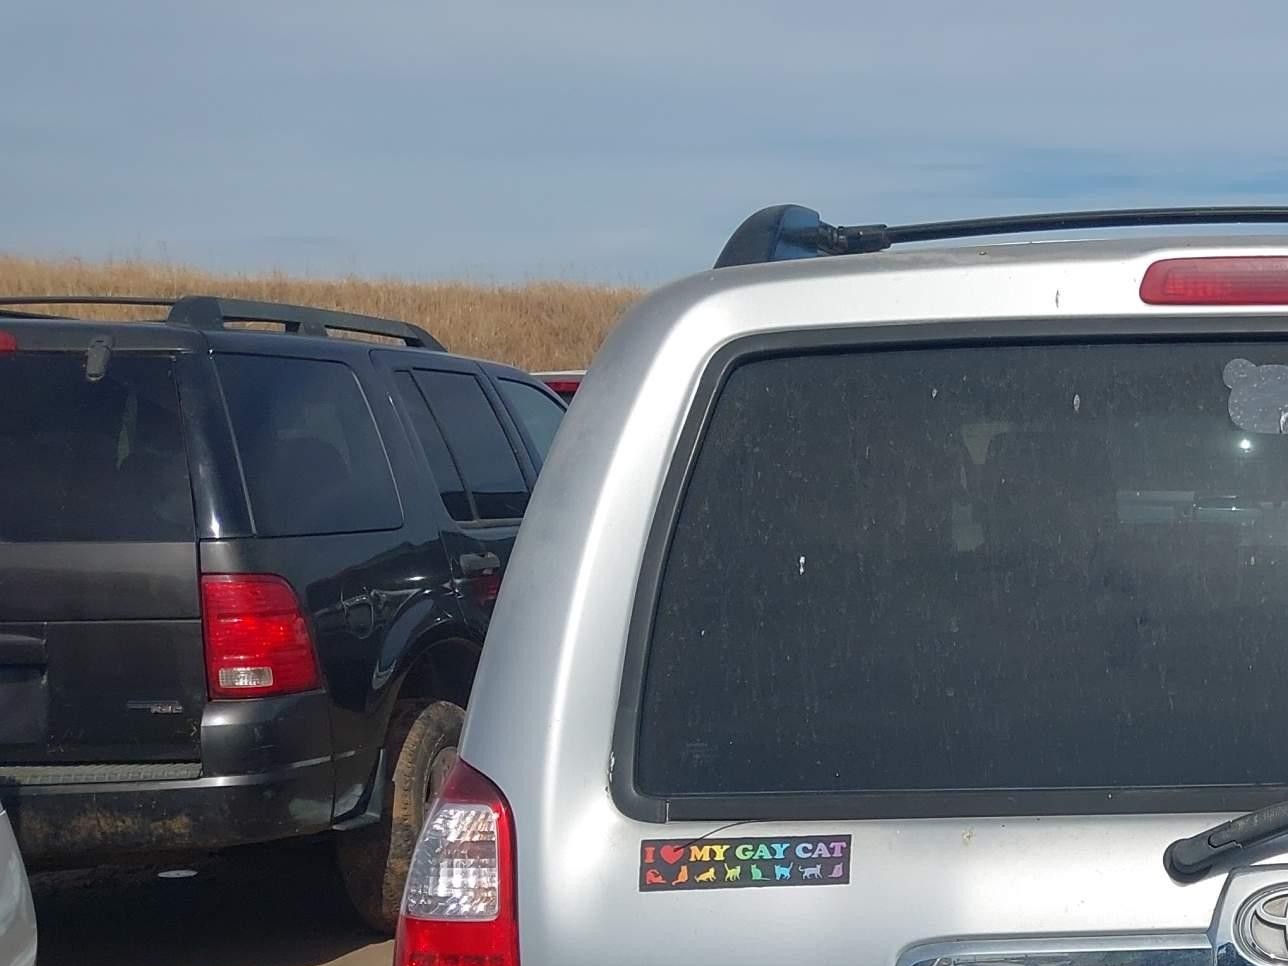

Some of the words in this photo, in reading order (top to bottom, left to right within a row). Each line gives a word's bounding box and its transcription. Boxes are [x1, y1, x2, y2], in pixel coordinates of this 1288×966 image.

[644, 848, 655, 863] I
[689, 844, 731, 862] MY
[735, 843, 791, 860] GAY
[795, 842, 847, 859] CAT
